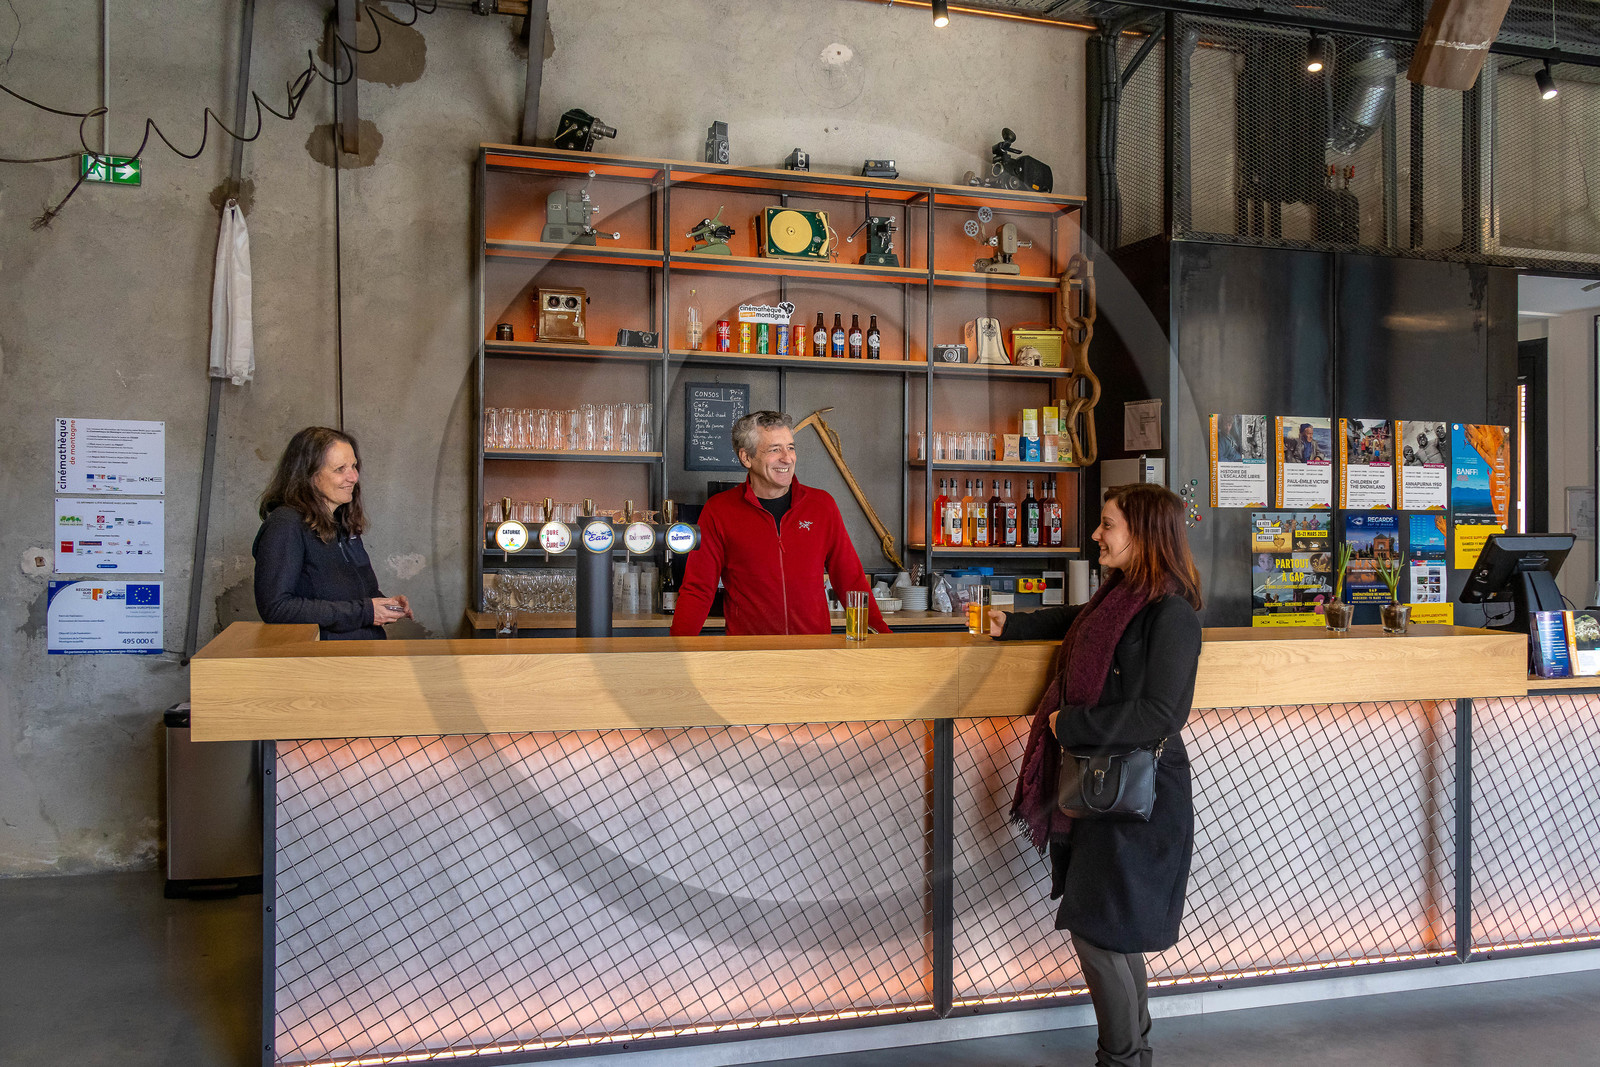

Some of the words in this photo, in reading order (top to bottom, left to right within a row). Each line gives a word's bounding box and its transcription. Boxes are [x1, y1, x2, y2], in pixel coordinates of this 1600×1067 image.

[58, 420, 68, 490] cinémathèque
[70, 456, 76, 465] de
[1276, 559, 1309, 568] PARTOUT
[1289, 572, 1304, 582] GAP
